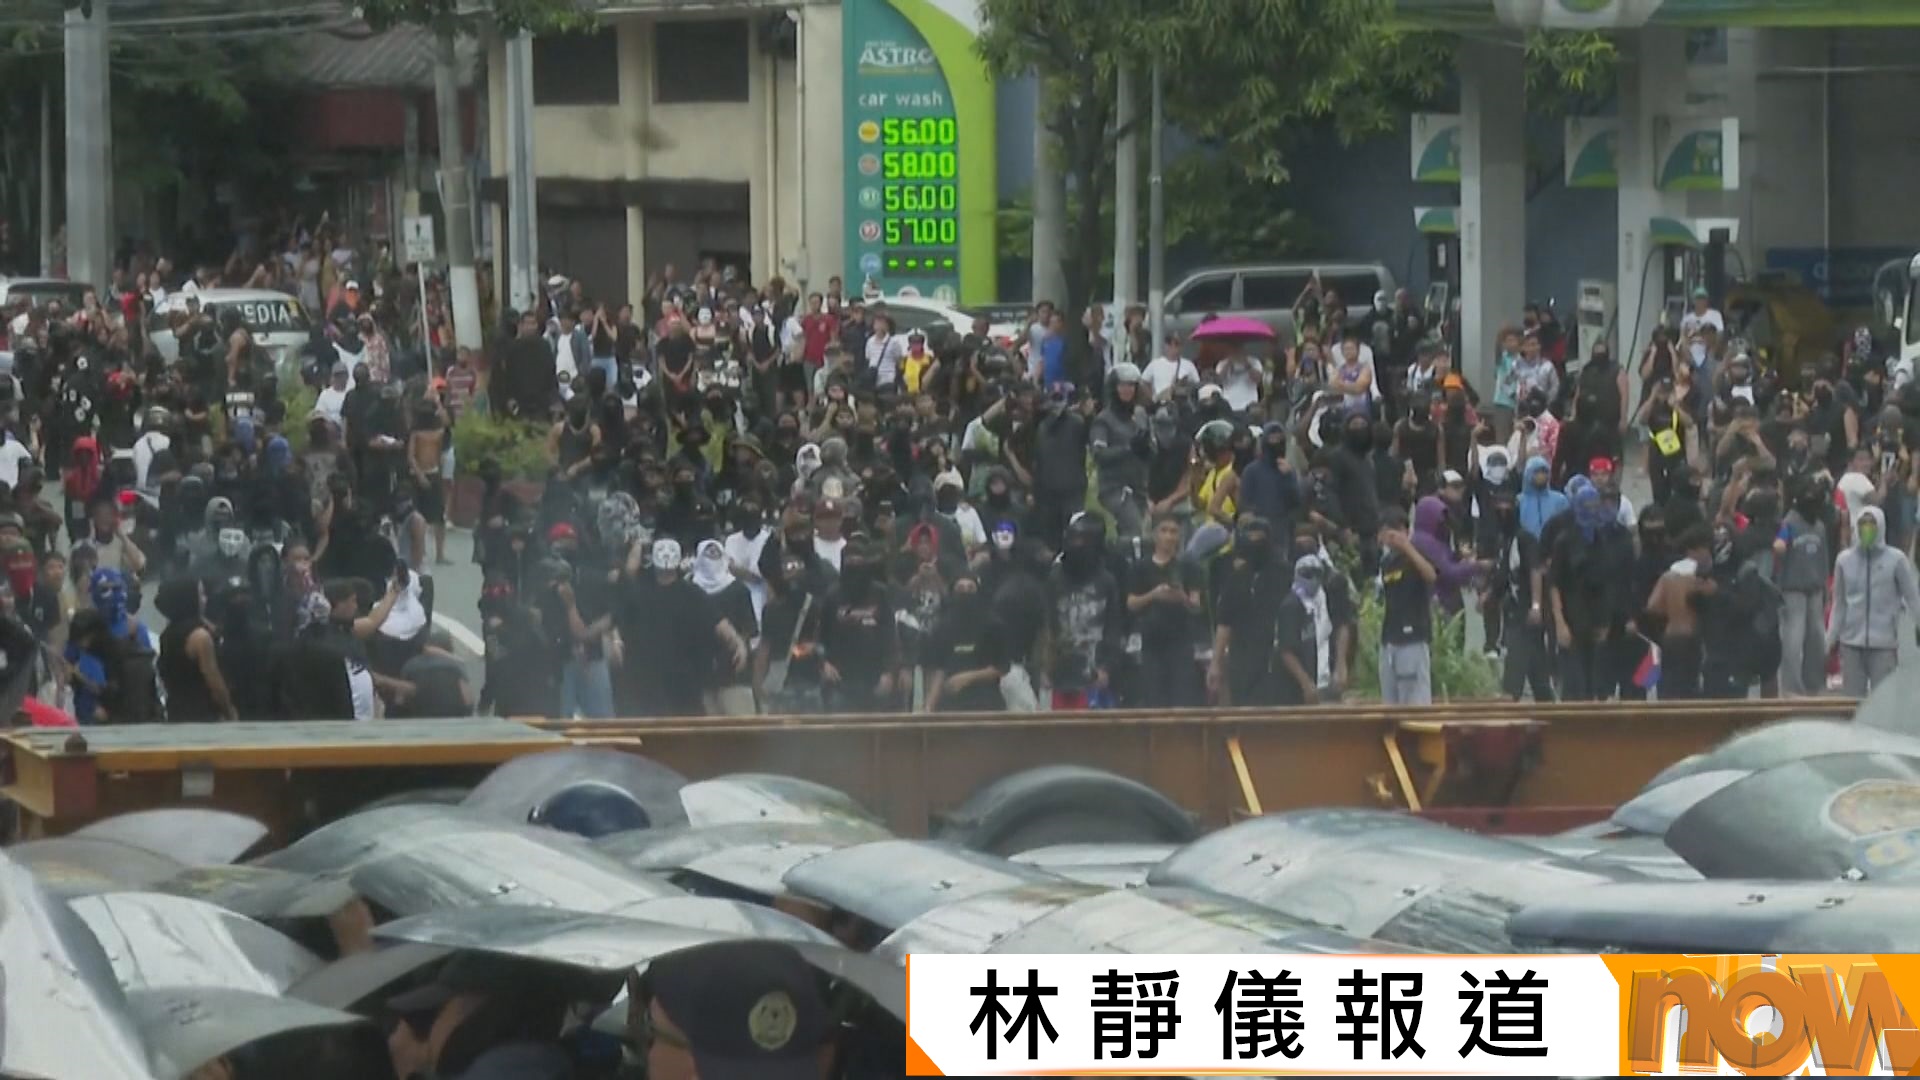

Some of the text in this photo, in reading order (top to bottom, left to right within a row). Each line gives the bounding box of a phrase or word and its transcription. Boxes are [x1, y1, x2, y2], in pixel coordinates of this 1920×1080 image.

[859, 90, 942, 106] car wash
[884, 118, 955, 145] 56.00
[884, 152, 955, 178] 58.00
[885, 185, 955, 211] 56.00
[885, 218, 955, 244] 57.00
[236, 303, 292, 326] EDIA
